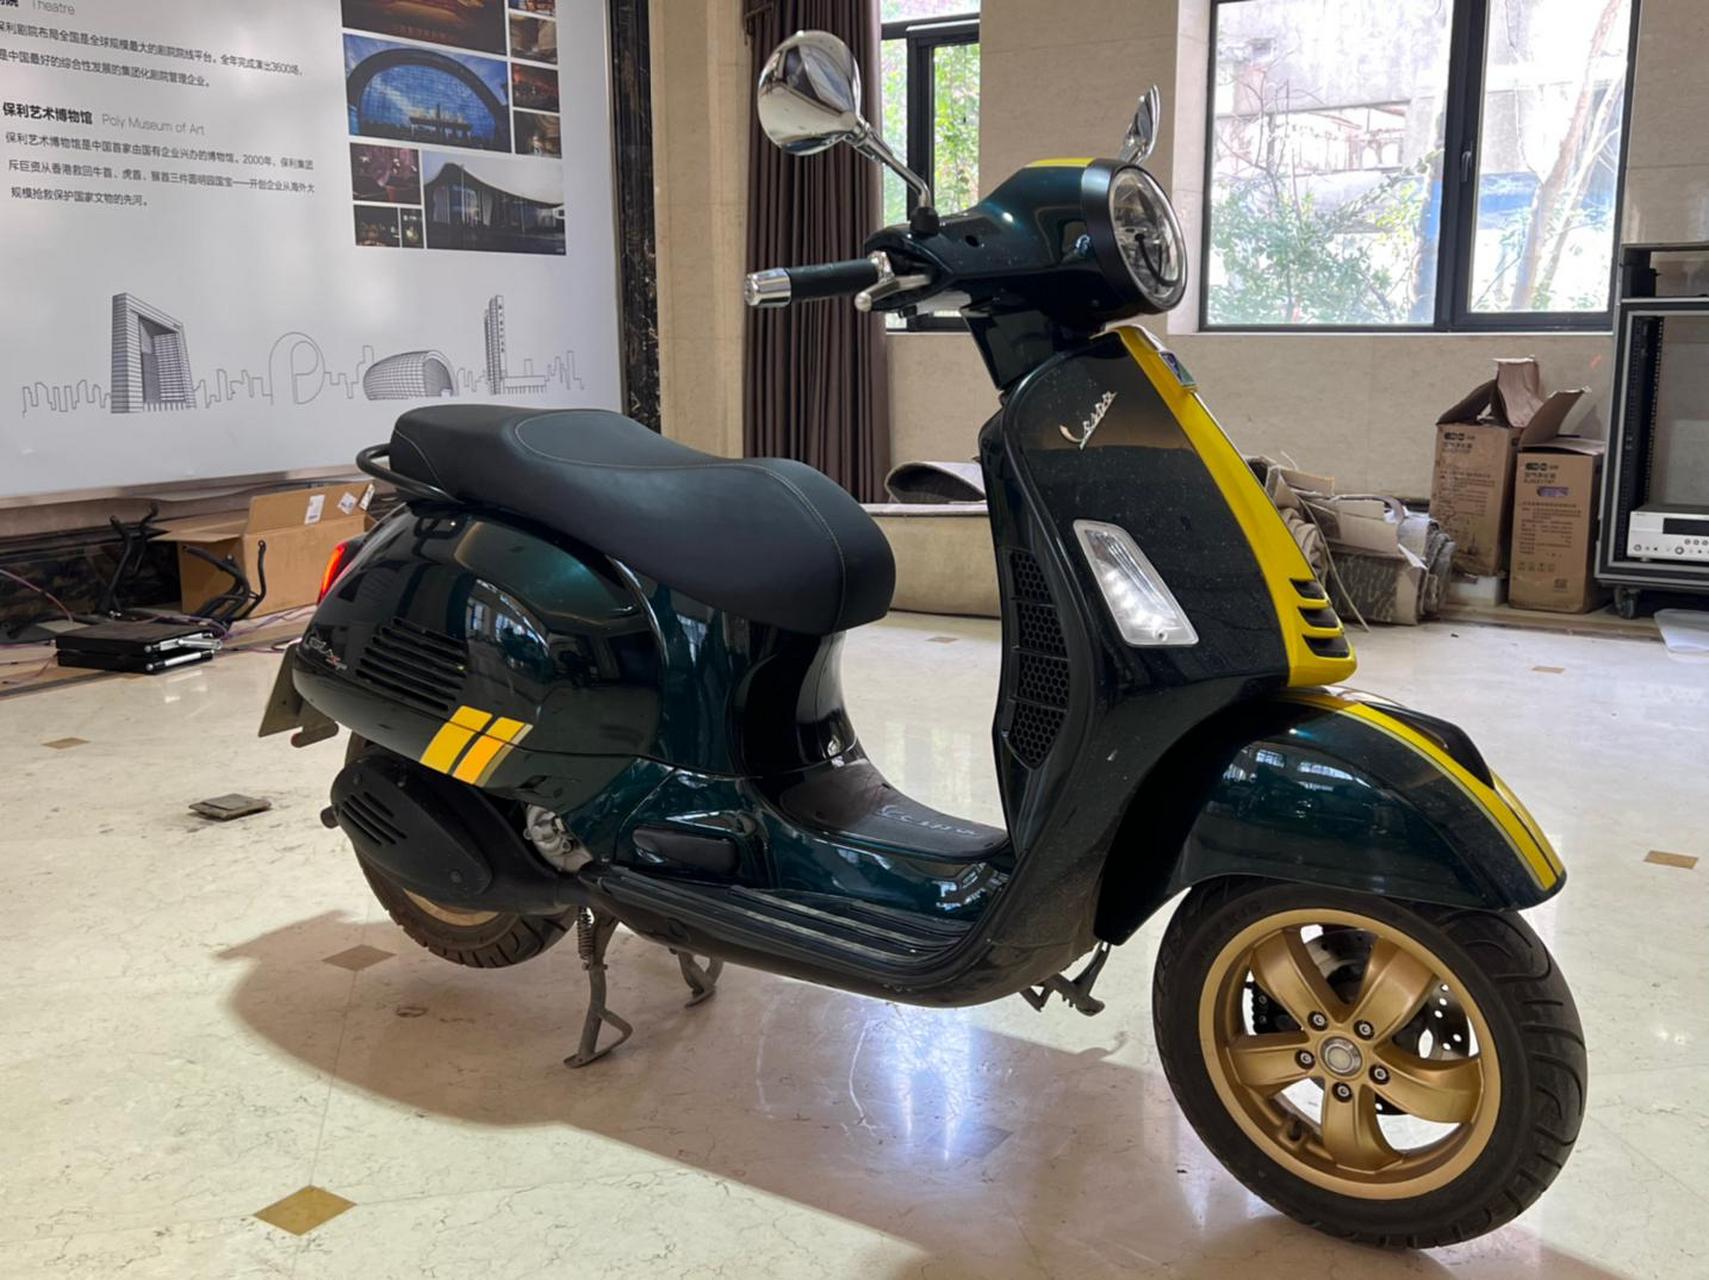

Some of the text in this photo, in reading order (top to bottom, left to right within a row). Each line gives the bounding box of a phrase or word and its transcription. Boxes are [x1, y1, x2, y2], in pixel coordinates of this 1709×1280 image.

[3, 102, 93, 125] 保利艺术博物馆
[102, 113, 205, 136] Poly Museum of Art
[1060, 391, 1118, 449] Vespa
